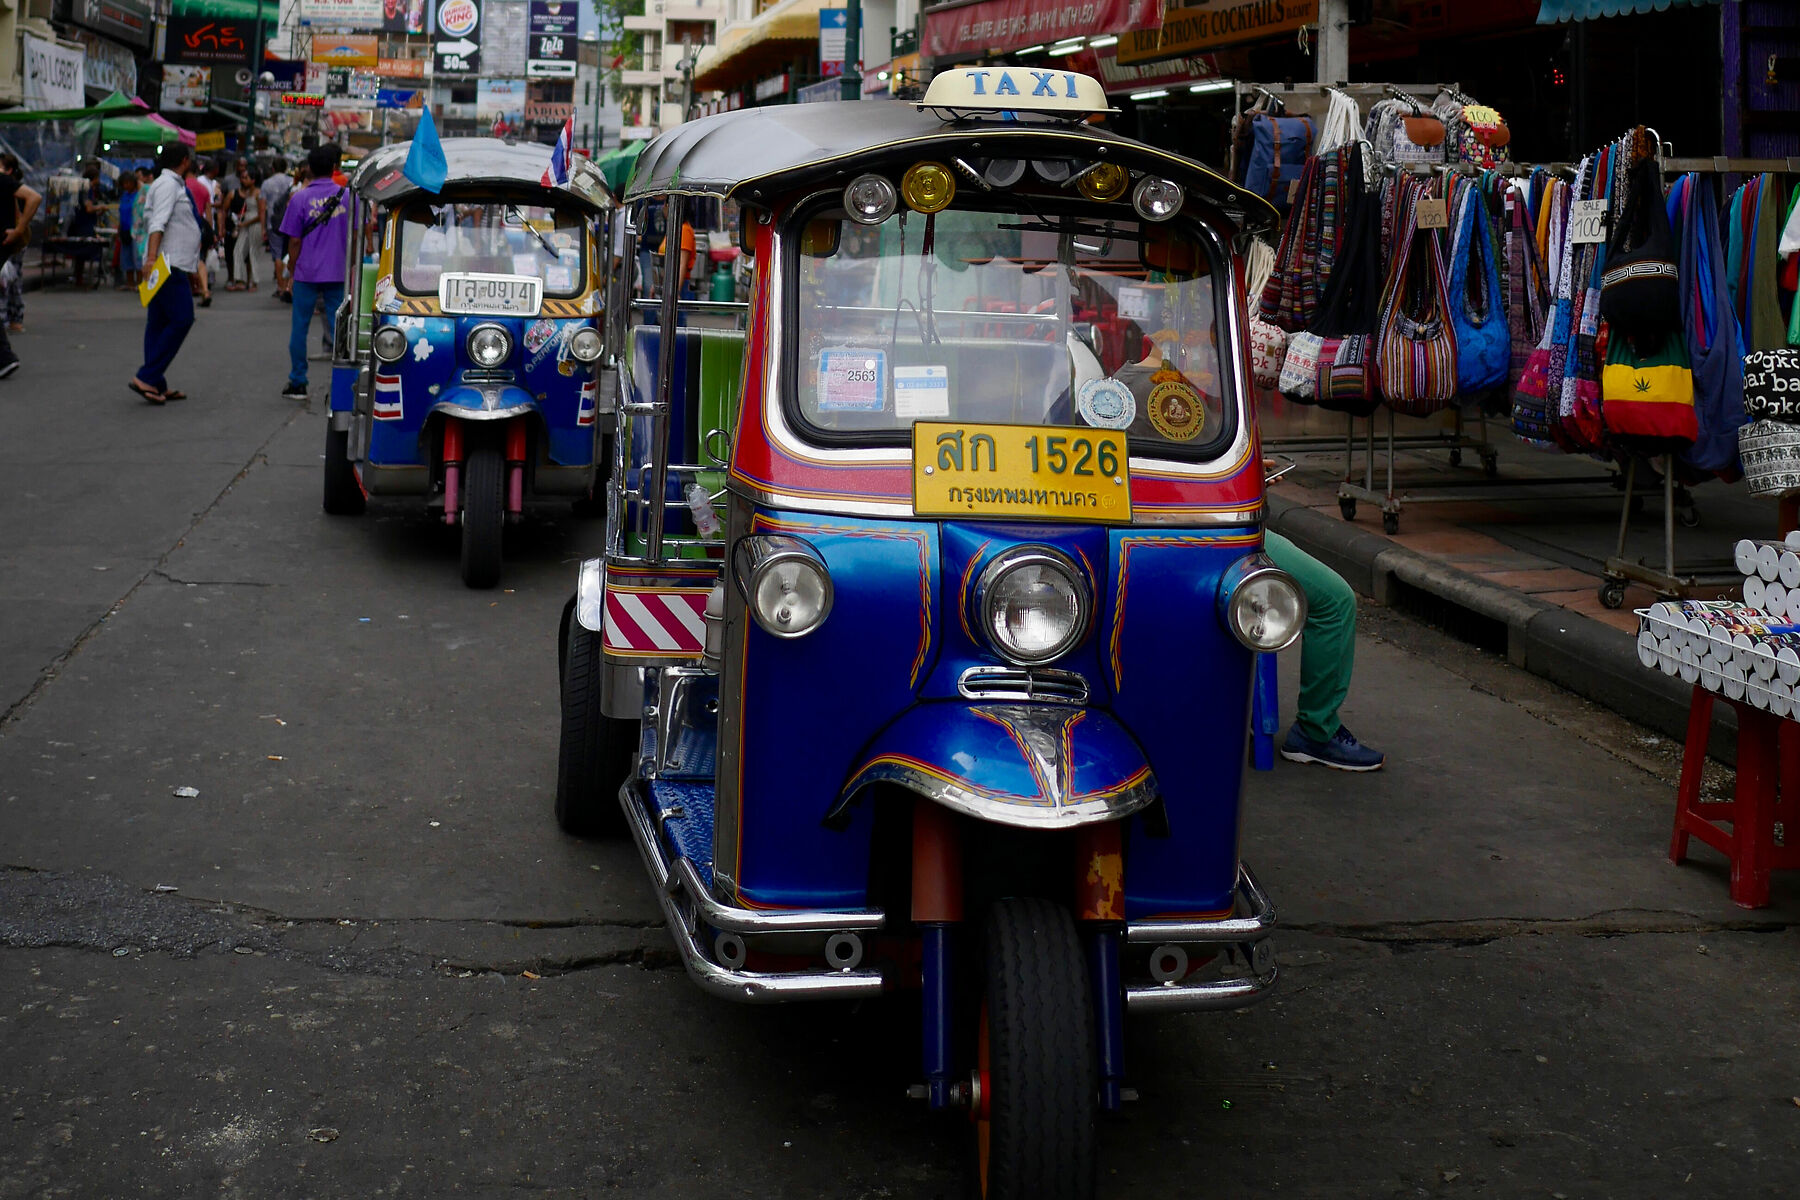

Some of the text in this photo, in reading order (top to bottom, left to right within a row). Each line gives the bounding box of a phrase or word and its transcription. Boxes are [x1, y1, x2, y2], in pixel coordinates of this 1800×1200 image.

[444, 4, 472, 17] BURGER
[445, 10, 473, 27] KING
[1162, 13, 1208, 47] STRONG
[540, 35, 565, 53] ZeZe
[966, 71, 1079, 98] TAXI
[1469, 111, 1493, 122] 100
[1582, 200, 1600, 211] SALE
[1422, 213, 1442, 226] 120
[1574, 216, 1600, 238] 100
[847, 370, 876, 382] 2563
[937, 430, 1118, 478] สก 1526
[949, 486, 1097, 508] กรุงเทพมหานคร
